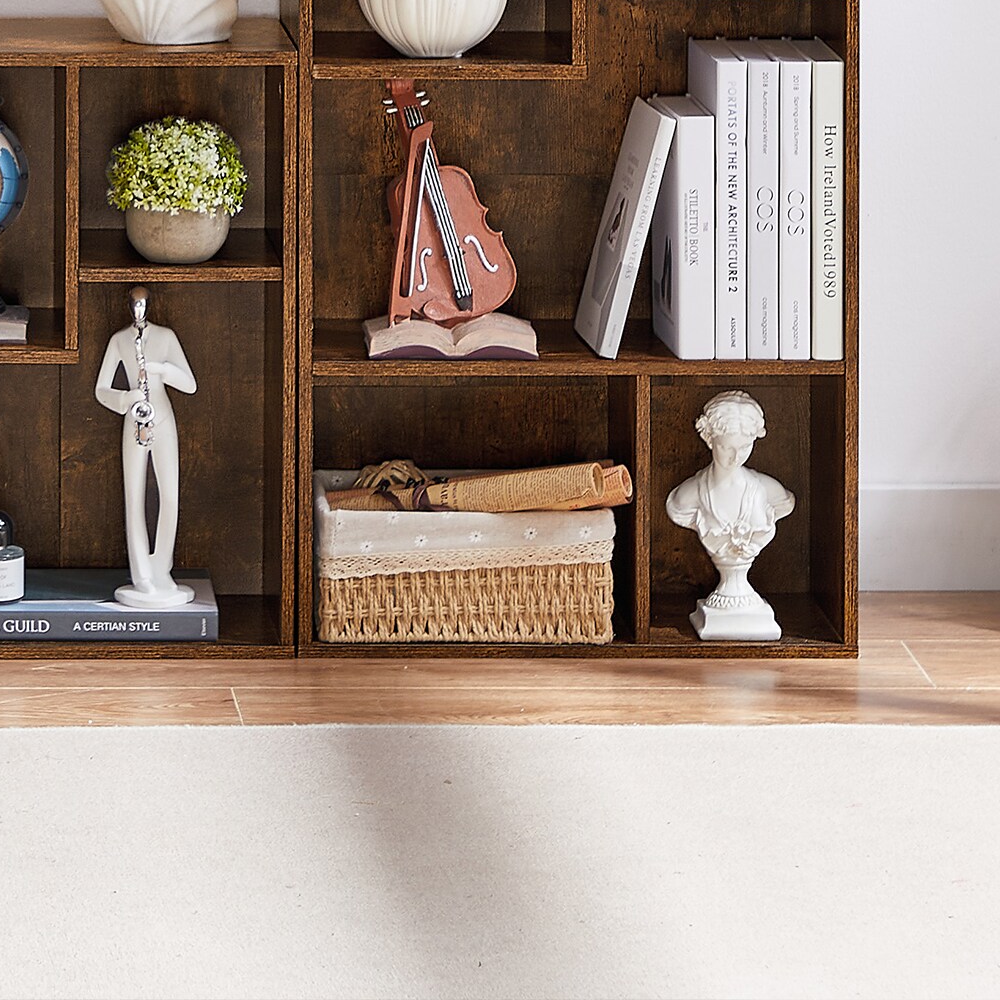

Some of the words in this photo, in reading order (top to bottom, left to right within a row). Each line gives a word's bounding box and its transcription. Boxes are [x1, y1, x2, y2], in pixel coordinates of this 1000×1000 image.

[727, 81, 737, 128] PORTATS
[727, 132, 737, 147] OF
[824, 125, 836, 159] How
[727, 151, 737, 170] THE
[644, 157, 661, 202] LEARNING
[727, 174, 737, 200] NEW
[637, 204, 649, 228] FROM
[688, 188, 698, 234] STILETTO
[756, 185, 774, 233] COS
[787, 189, 804, 236] COS
[688, 238, 698, 266] BOOK
[728, 203, 738, 282] ARCHITECTURE
[624, 251, 637, 279] VEGAS
[3, 619, 50, 633] GUILD
[72, 621, 81, 632] A
[83, 621, 126, 632] CERTIAN
[128, 621, 160, 632] STYLE
